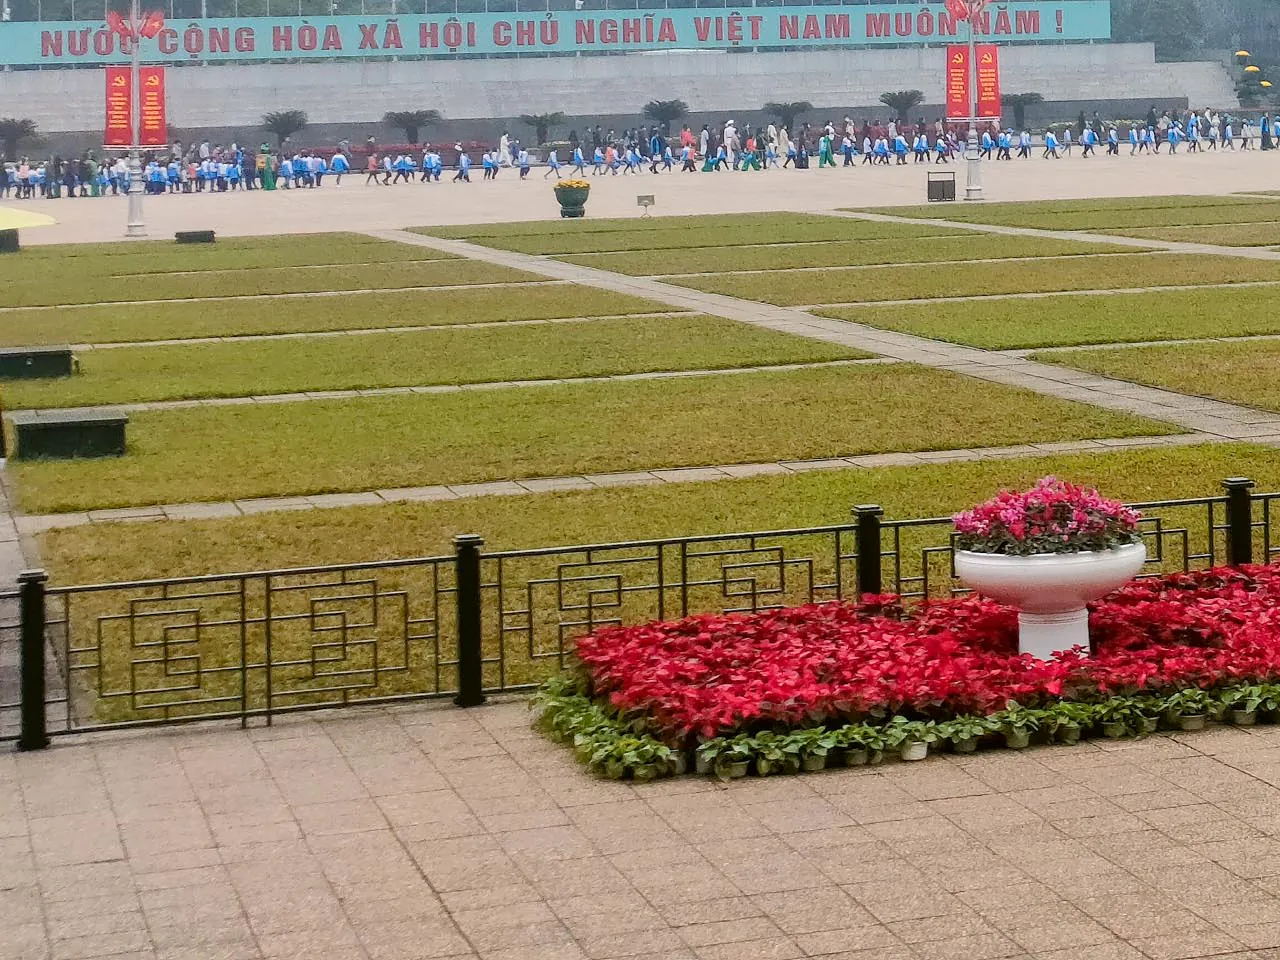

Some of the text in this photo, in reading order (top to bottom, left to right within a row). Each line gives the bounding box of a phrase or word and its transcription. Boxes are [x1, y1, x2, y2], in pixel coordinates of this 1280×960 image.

[158, 22, 255, 59] CỘNG
[272, 20, 342, 51] HÒA
[358, 18, 403, 50] XÃ
[419, 17, 475, 52] HỘI
[493, 12, 559, 46] CHỦ
[575, 13, 677, 44] NGHĨA
[694, 11, 763, 46] VIỆT
[779, 13, 850, 40] NAM
[866, 7, 957, 38] MUÔN
[971, 5, 1040, 35] NĂM
